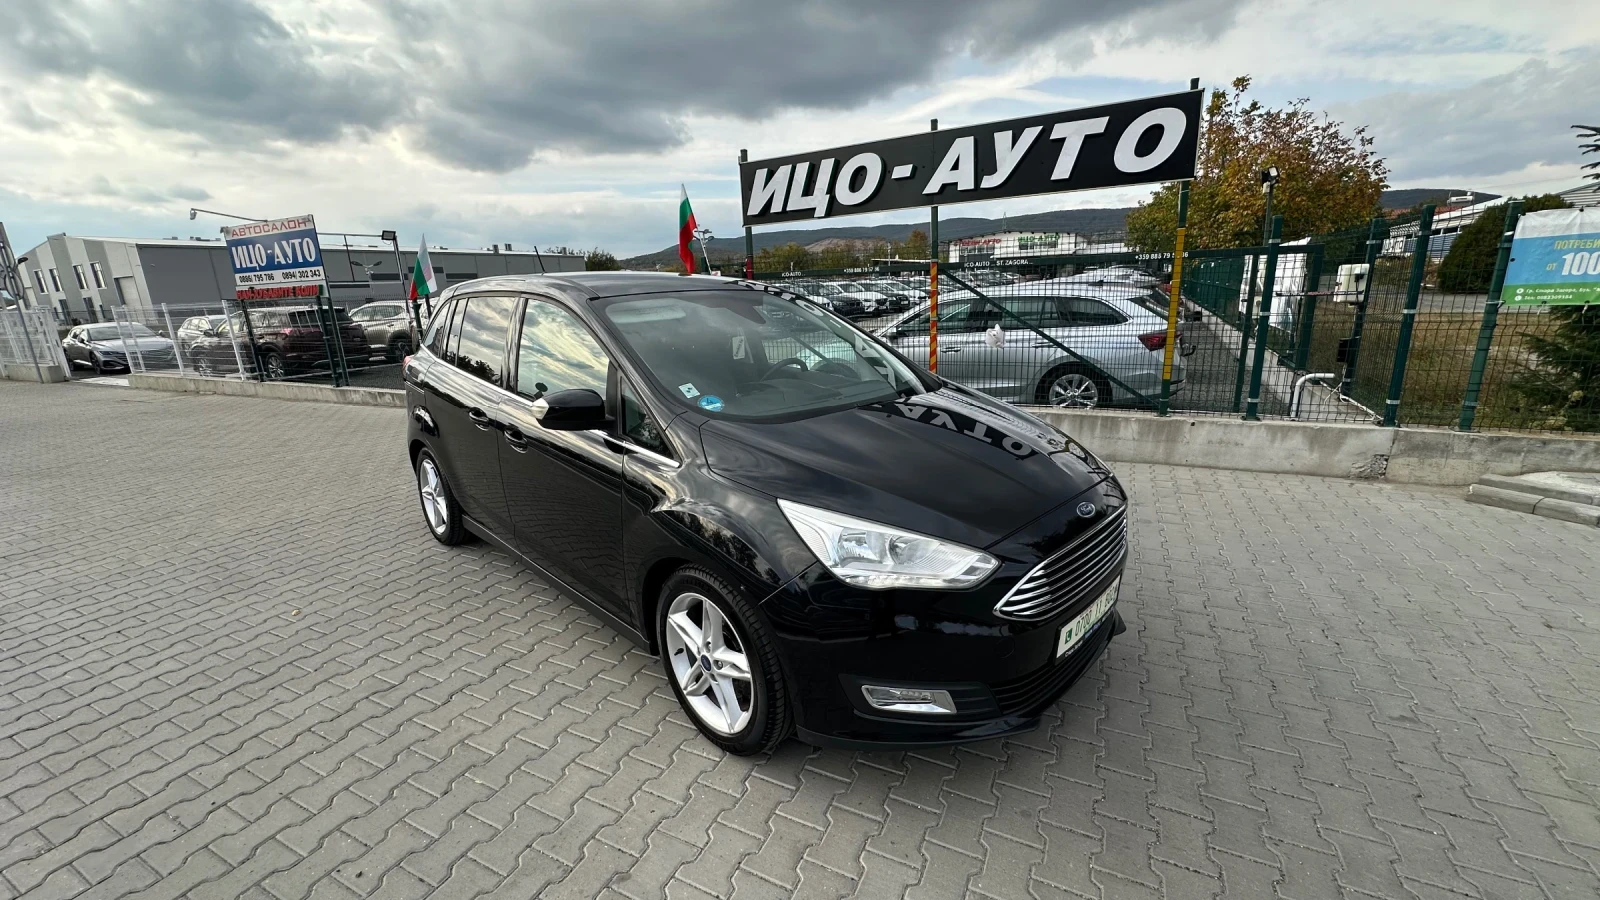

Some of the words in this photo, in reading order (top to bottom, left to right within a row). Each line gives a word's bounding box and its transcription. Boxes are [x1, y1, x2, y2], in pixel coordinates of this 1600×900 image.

[747, 107, 1187, 217] ИЦО-АУТО
[231, 219, 307, 238] АВТОСАЛОН
[231, 237, 316, 270] ИЦО-АУТО
[298, 270, 309, 279] 302
[310, 269, 321, 278] 343
